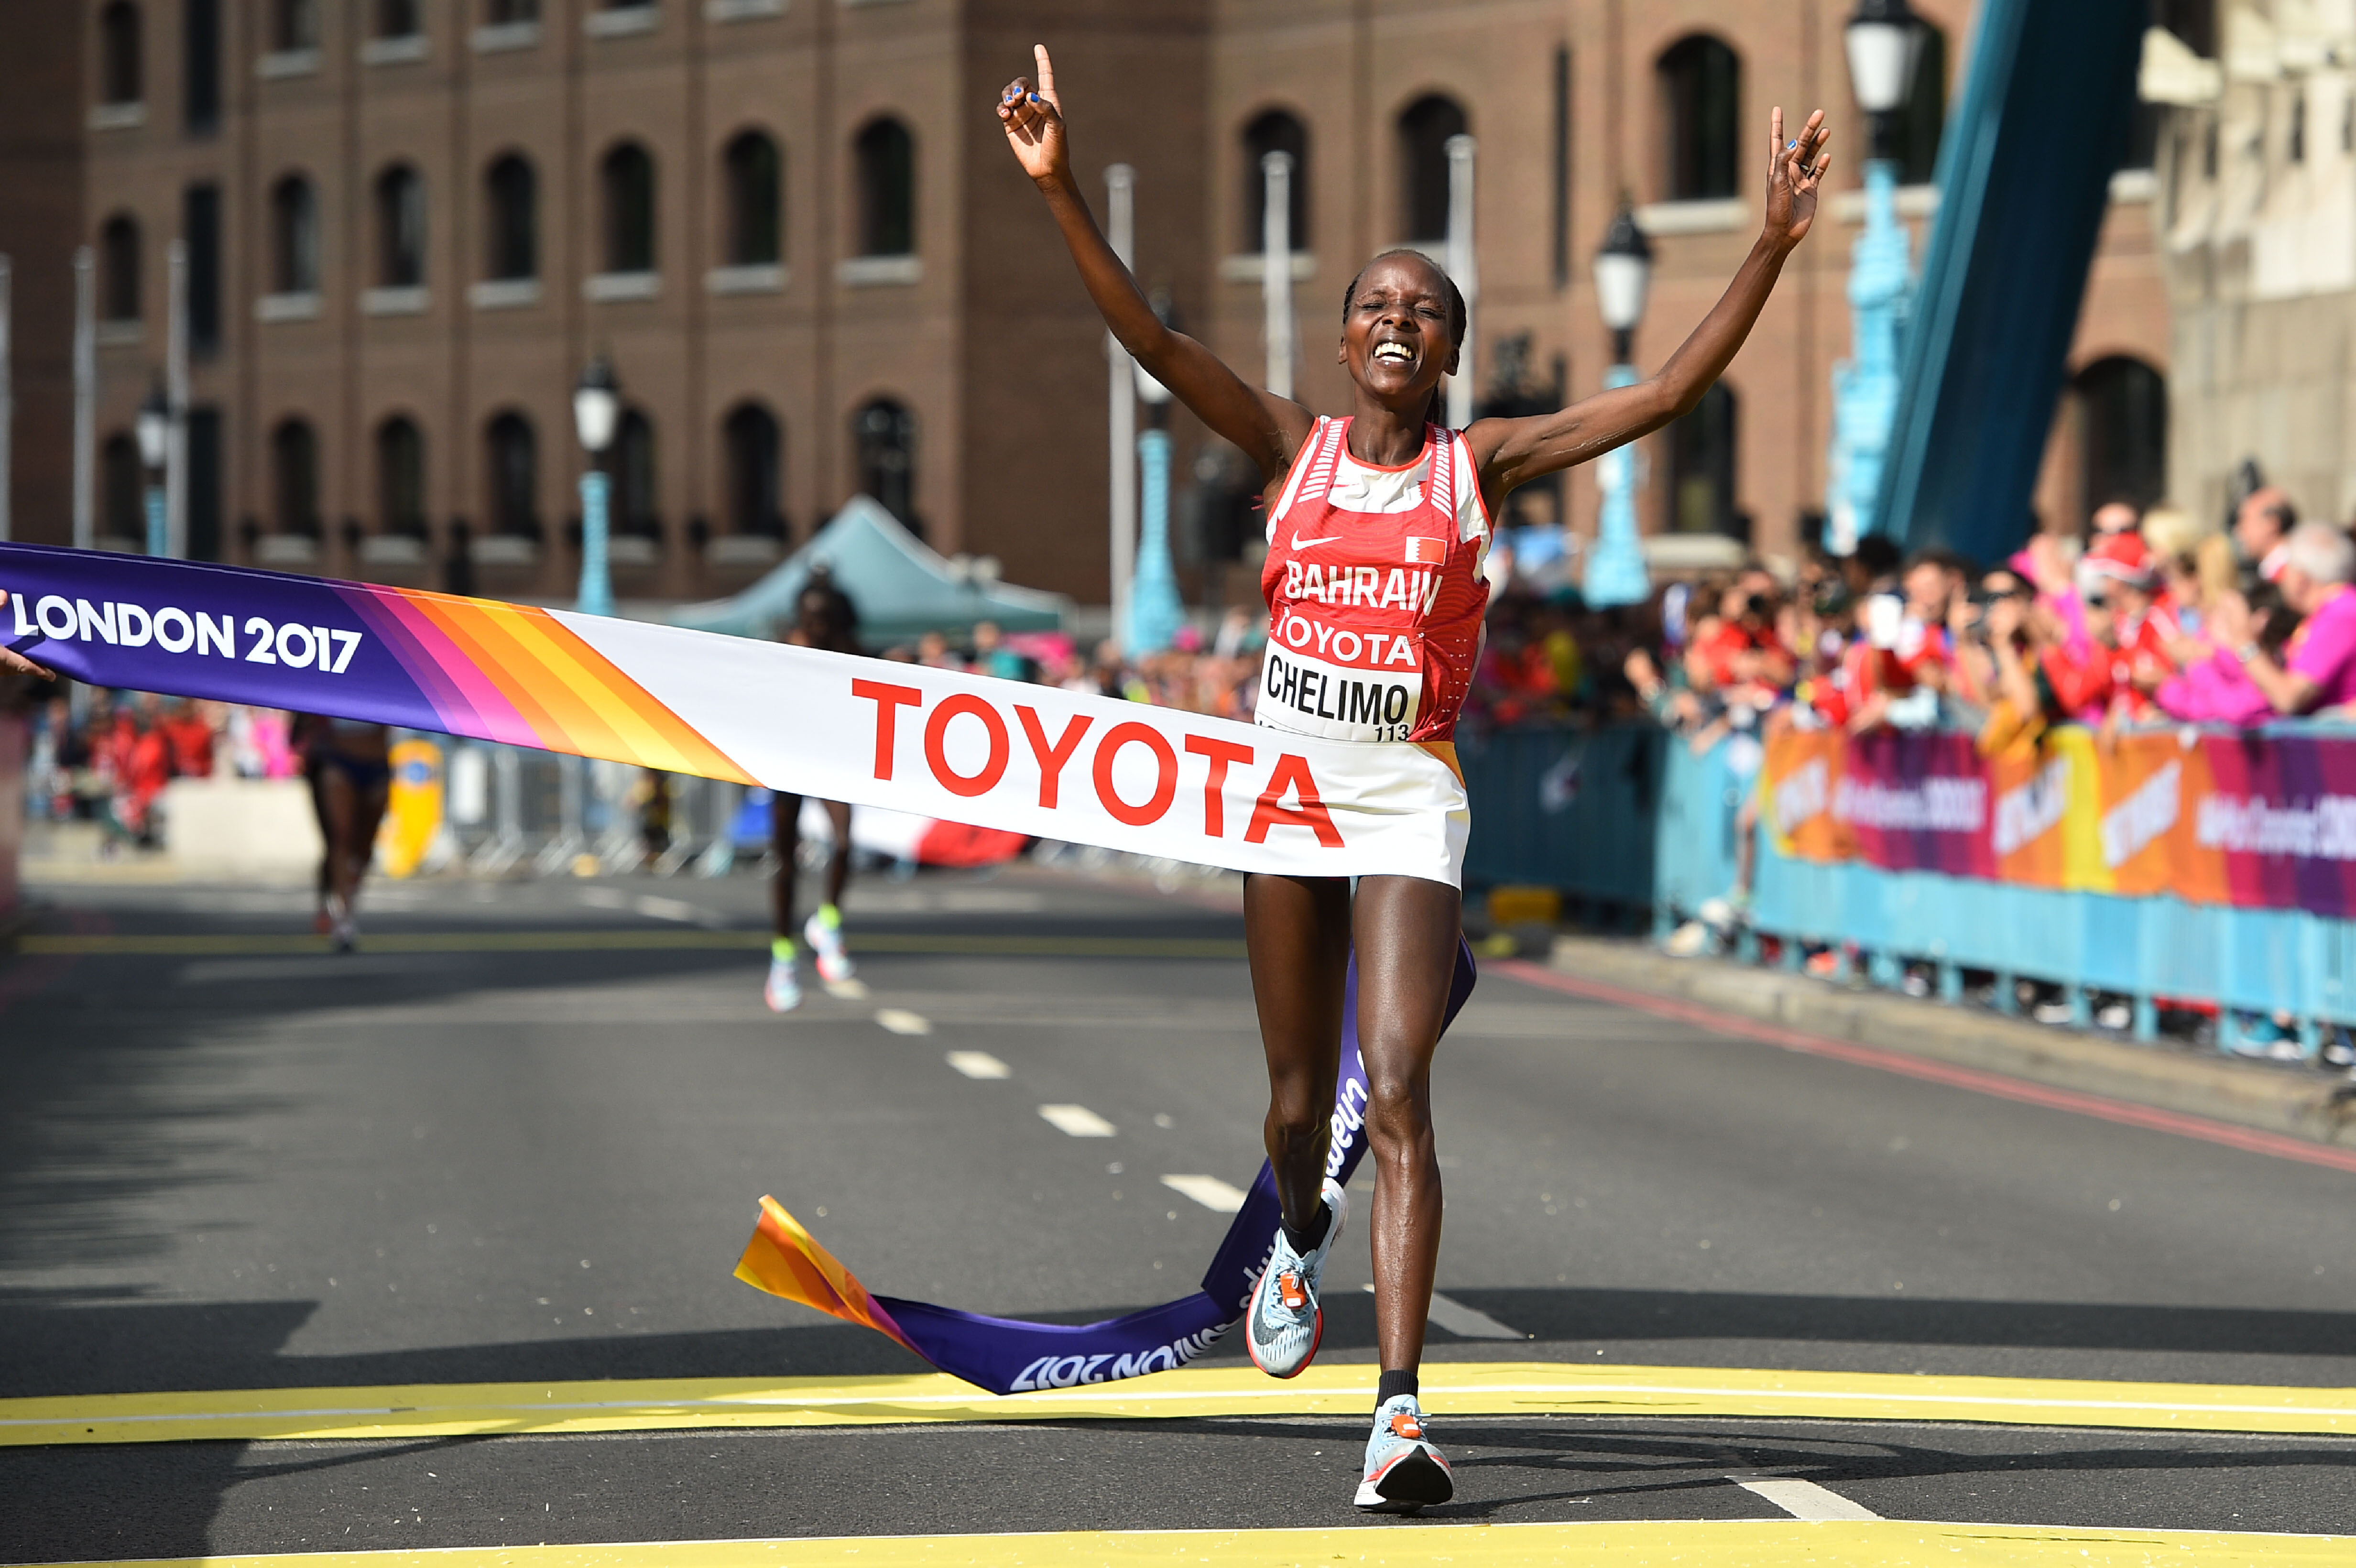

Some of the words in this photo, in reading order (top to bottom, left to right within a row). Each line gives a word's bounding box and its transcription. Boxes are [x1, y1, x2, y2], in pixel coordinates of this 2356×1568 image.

[1285, 559, 1443, 616] BAHRAIN
[11, 593, 235, 659] LONDON
[245, 617, 362, 674] 2017
[1267, 654, 1408, 726] CHELIMO
[852, 677, 1345, 848] TOYOTA
[1374, 724, 1409, 742] 113
[1010, 1353, 1115, 1391] 2017
